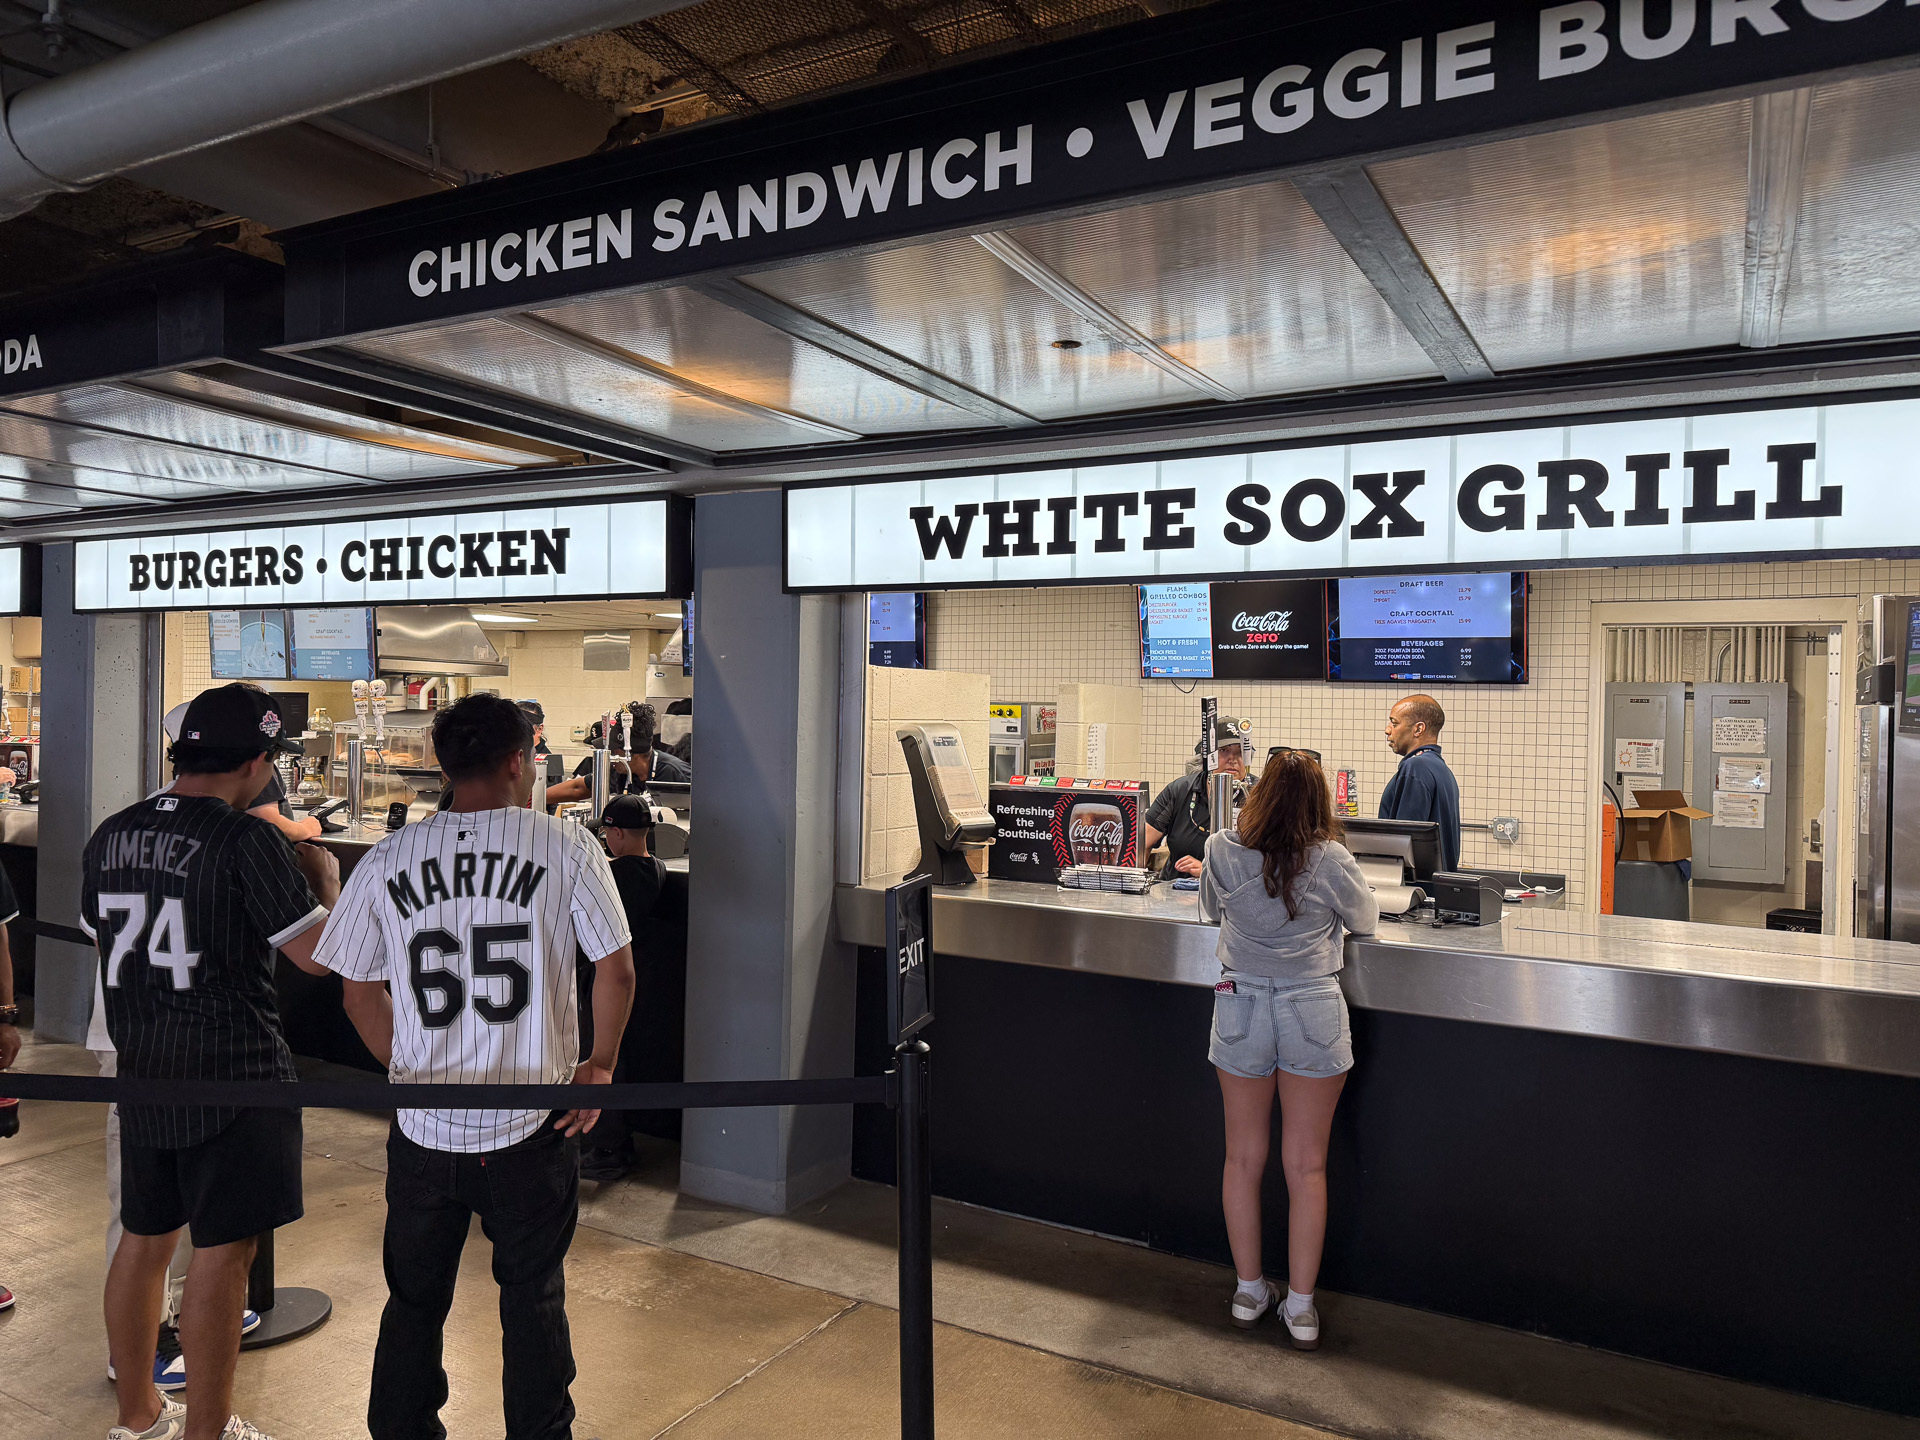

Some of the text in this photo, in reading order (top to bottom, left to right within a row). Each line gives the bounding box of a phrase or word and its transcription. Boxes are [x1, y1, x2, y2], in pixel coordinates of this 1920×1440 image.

[1126, 0, 1920, 159] VEGGIE BUR
[408, 123, 1033, 297] CHICKEN SANDWICH
[0, 334, 43, 374] DA
[909, 442, 1842, 560] WHITE SOX GRILL
[130, 527, 570, 592] BURGERS CHICKEN
[1232, 611, 1292, 632] Coca-Cola
[1246, 633, 1278, 642] zero
[996, 804, 1055, 818] Refreshing
[998, 828, 1053, 840] Southside
[1016, 818, 1034, 827] the
[1069, 818, 1123, 846] Coca-Cola
[101, 825, 202, 878] JIMÉNEZ
[386, 851, 548, 921] MARTIN
[97, 891, 204, 991] 74
[900, 937, 924, 974] EXIT
[407, 920, 532, 1030] 65
